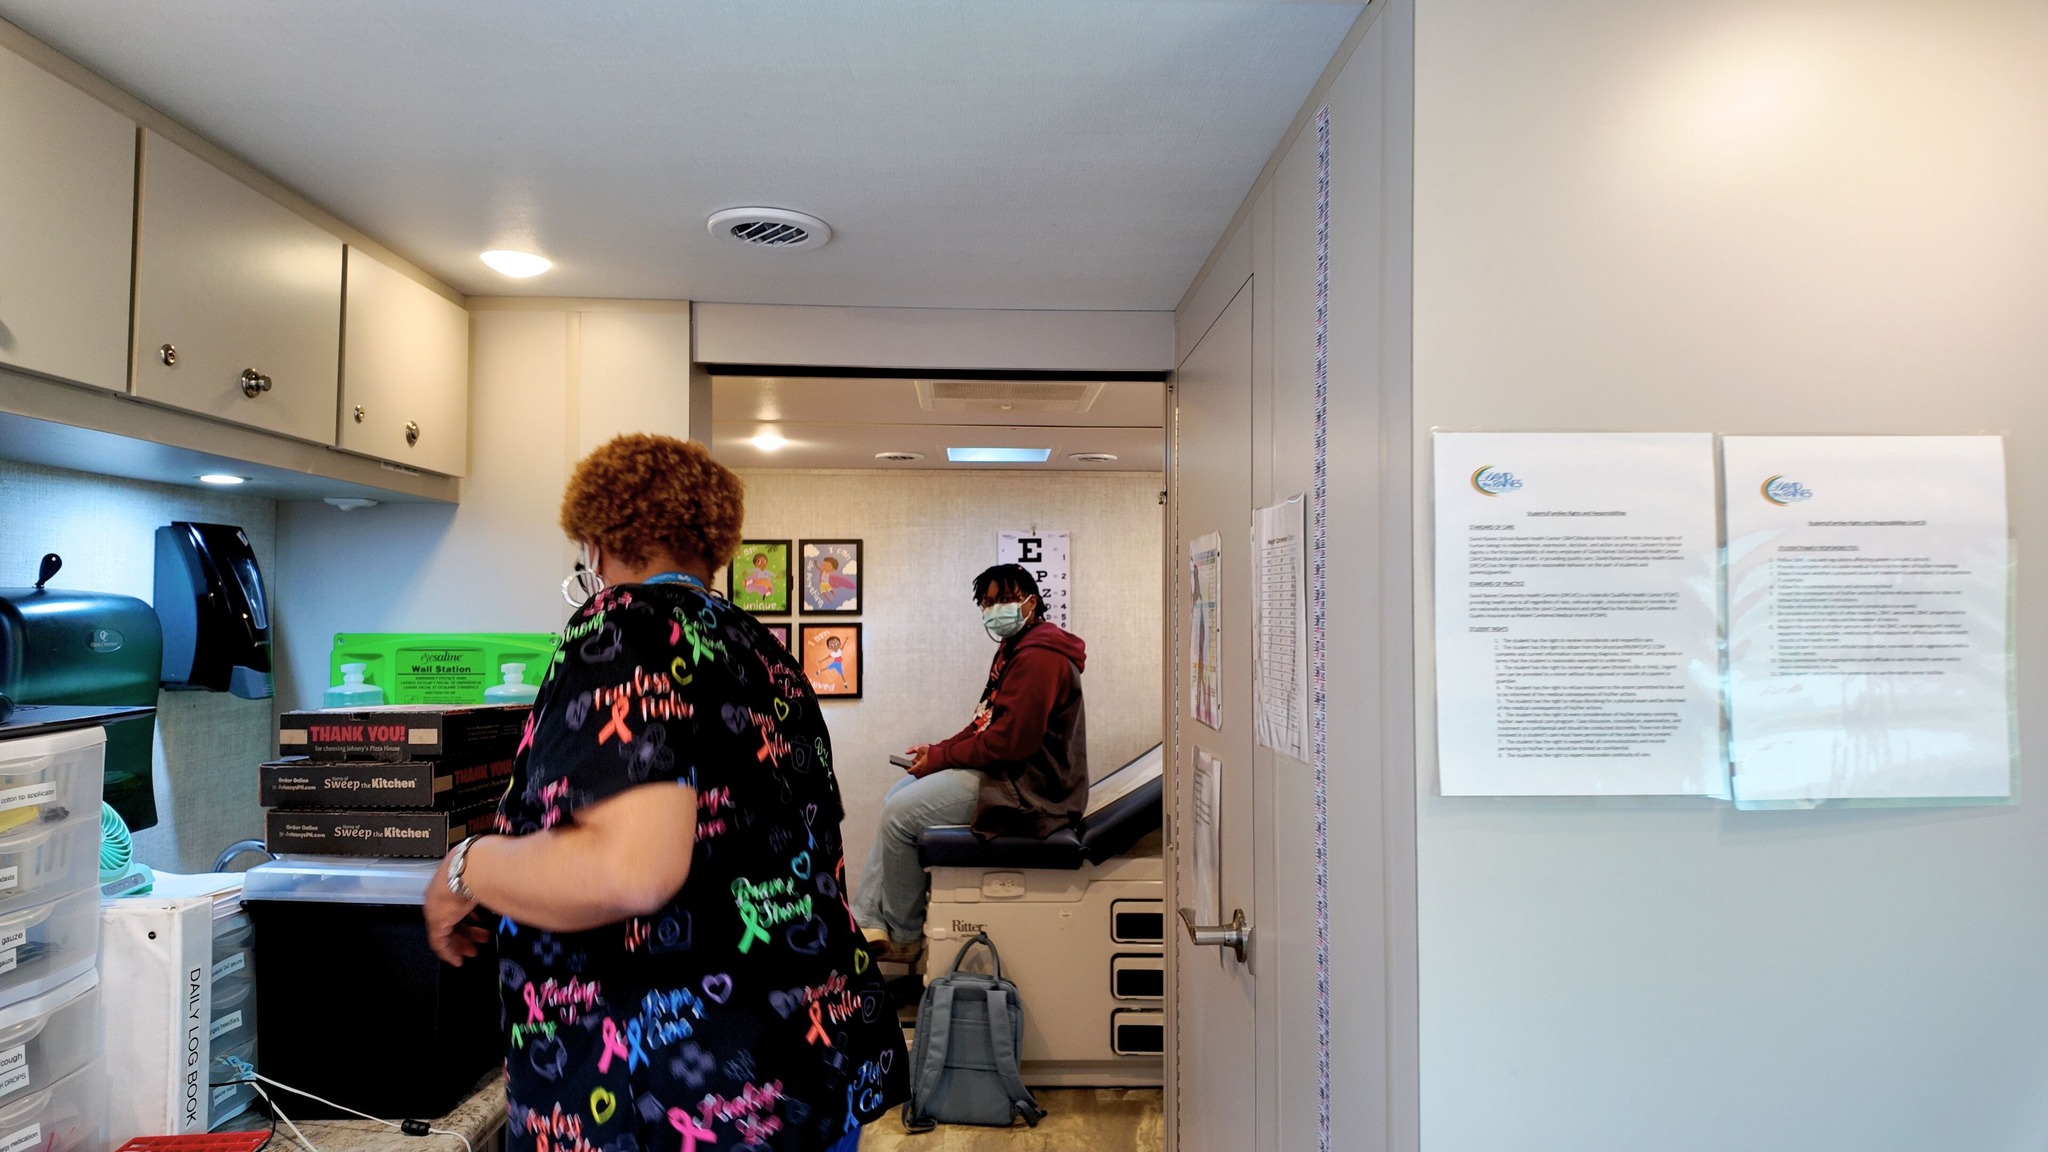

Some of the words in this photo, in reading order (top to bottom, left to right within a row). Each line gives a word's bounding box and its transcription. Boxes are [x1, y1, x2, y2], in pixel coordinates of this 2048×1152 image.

[1018, 538, 1042, 563] E
[1036, 570, 1048, 582] P
[1042, 588, 1052, 598] Z
[310, 726, 364, 742] THANK
[368, 726, 406, 742] YOU!
[323, 746, 346, 754] choosing
[346, 746, 368, 754] Johnny's
[324, 778, 360, 790] Sweep
[27, 790, 54, 798] applicator
[334, 826, 372, 840] Sweep
[952, 920, 983, 932] Ritter
[2, 933, 23, 945] gauze
[190, 968, 200, 1019] DAILY
[188, 1026, 199, 1067] LOG
[0, 1053, 22, 1067] cough
[5, 1073, 26, 1086] DROPS
[186, 1070, 198, 1126] BOOK
